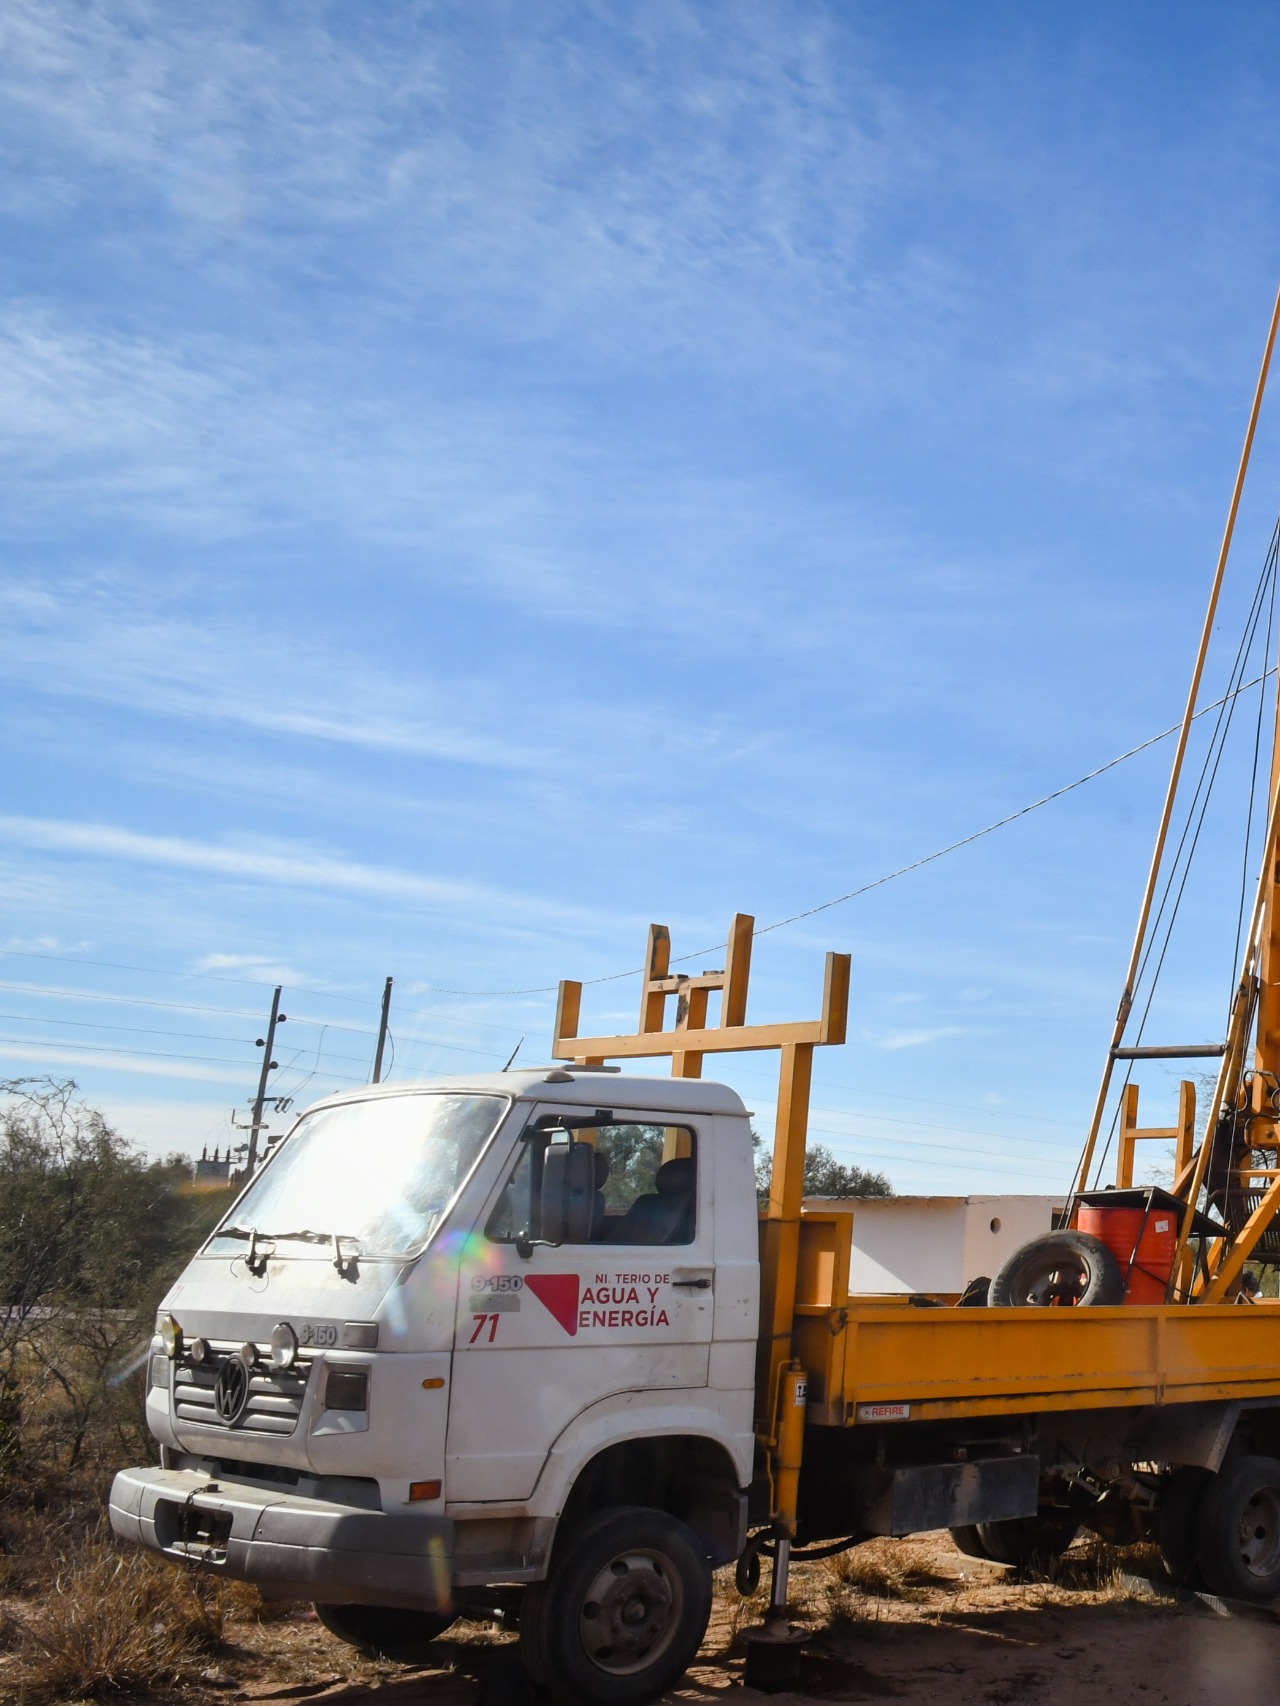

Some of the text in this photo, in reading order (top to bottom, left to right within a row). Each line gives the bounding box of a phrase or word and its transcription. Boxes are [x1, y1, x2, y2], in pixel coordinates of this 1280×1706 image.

[615, 1273, 651, 1284] TERIO
[654, 1274, 670, 1284] DE
[580, 1287, 660, 1304] AGUA Y
[579, 1305, 670, 1328] ENERGÍA
[469, 1313, 500, 1345] 71
[872, 1406, 904, 1416] REFIRE
